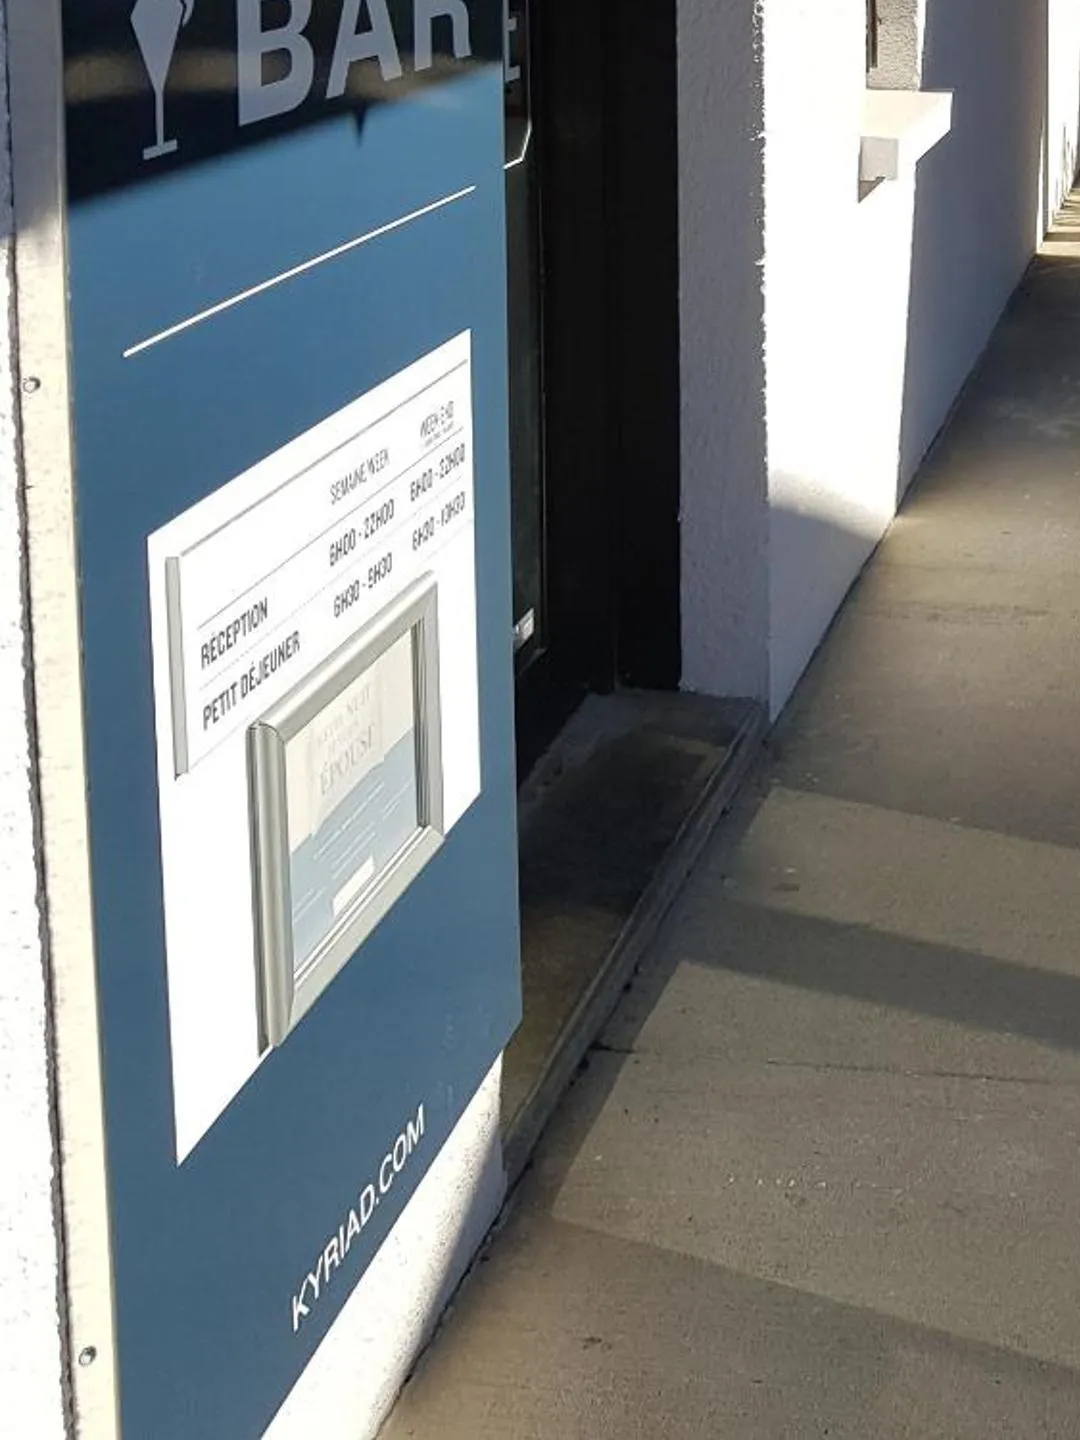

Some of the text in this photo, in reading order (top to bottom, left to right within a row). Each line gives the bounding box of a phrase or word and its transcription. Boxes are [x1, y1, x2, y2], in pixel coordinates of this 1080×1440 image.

[202, 681, 238, 731] PETIT
[240, 630, 300, 699] DÉJEUNER
[291, 1103, 426, 1332] KYRIAD.COM
